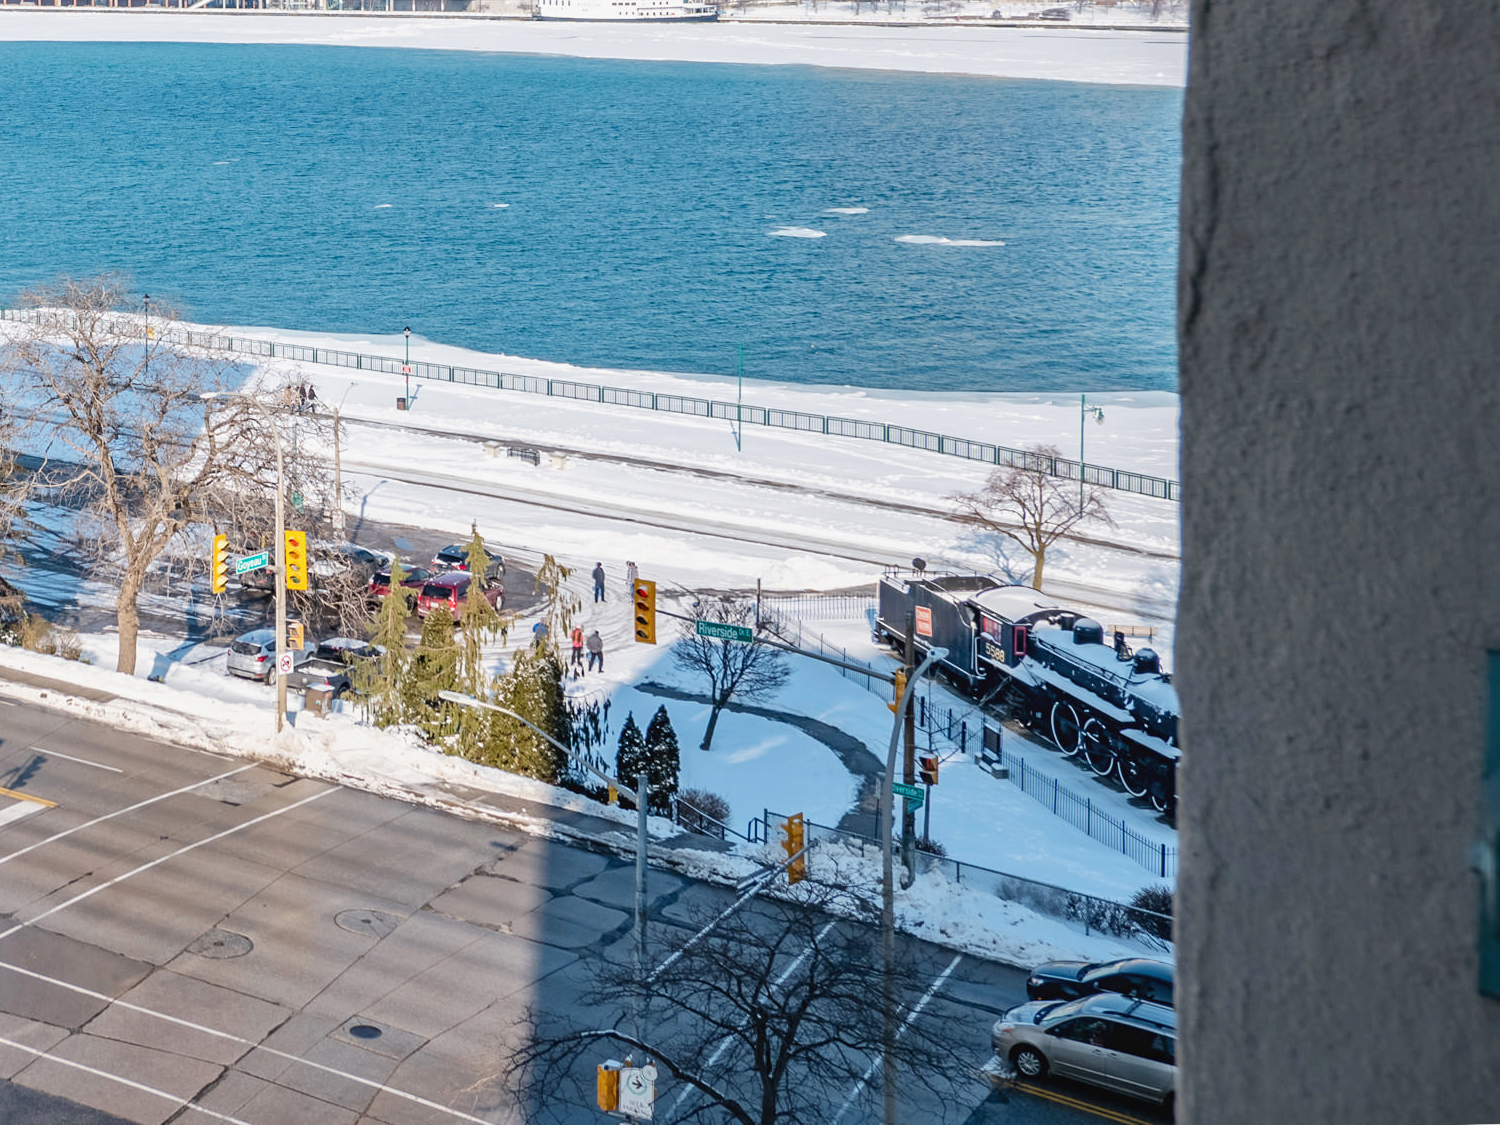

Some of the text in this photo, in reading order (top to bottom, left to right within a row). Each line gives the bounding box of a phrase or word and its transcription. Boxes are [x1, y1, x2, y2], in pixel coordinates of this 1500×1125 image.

[237, 557, 262, 570] Goyeau
[698, 622, 738, 639] Riverside
[985, 642, 1005, 663] 5588
[892, 784, 917, 796] iverside
